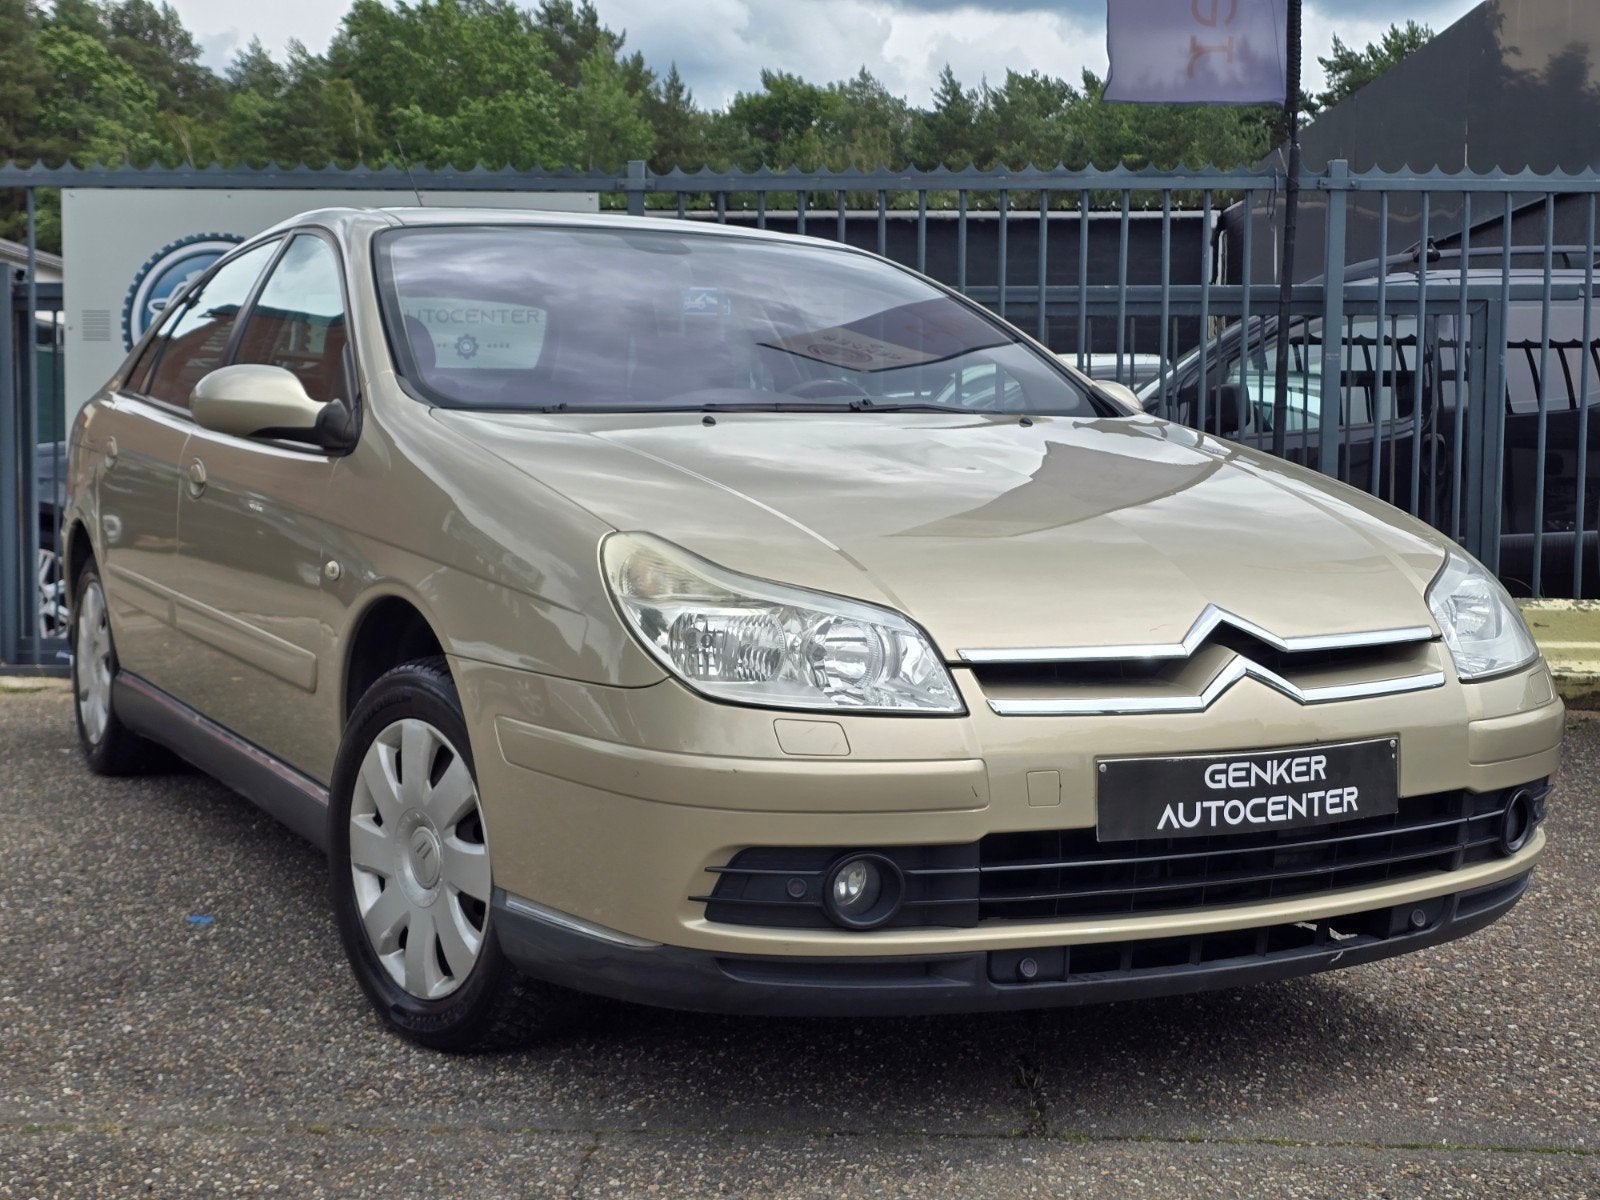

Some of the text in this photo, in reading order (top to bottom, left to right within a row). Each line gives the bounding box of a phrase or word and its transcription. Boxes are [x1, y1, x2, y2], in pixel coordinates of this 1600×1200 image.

[407, 309, 540, 324] UTOCENTER
[1204, 755, 1327, 789] GENKER
[1156, 786, 1359, 830] AUTOCENTER
